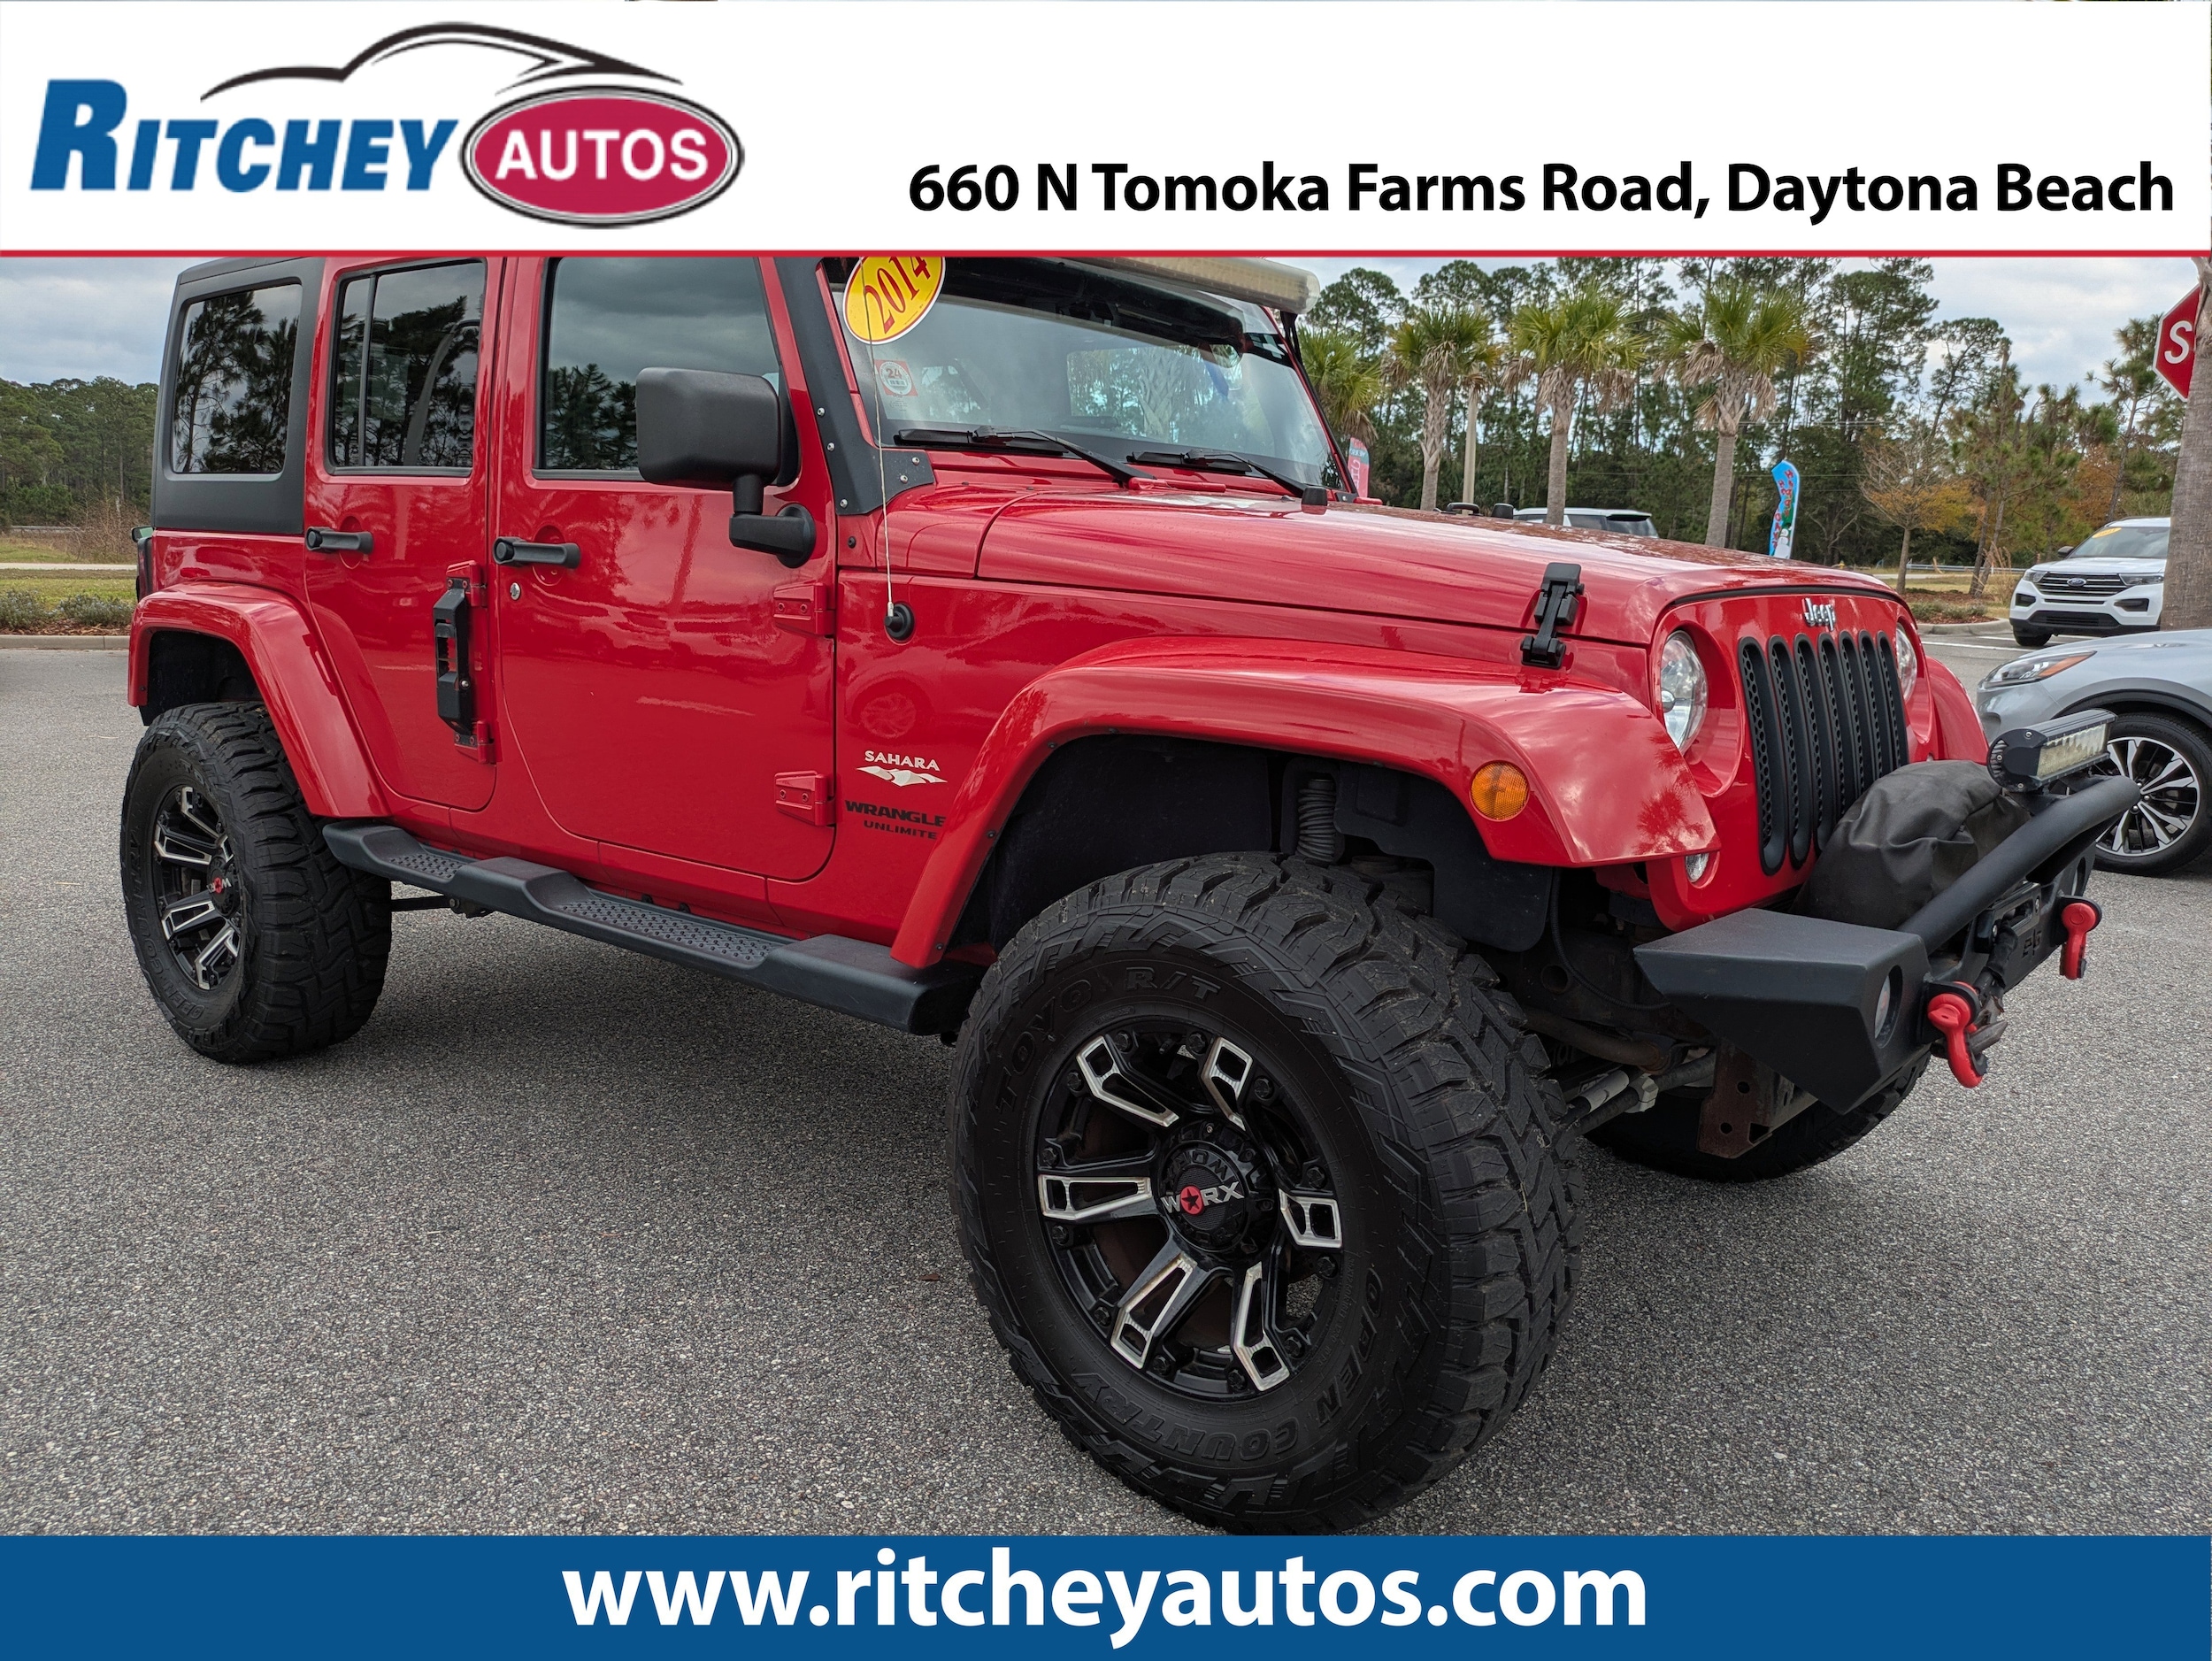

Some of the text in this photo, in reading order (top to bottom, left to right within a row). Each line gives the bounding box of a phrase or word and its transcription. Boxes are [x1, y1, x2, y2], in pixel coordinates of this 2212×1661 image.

[864, 257, 931, 334] 2014
[864, 750, 940, 772] SAHARA
[845, 800, 947, 827] WRANGLE
[864, 820, 937, 840] UNLIMITE
[995, 979, 1094, 1116] TOYO
[1125, 965, 1223, 1001] R/T
[1160, 1180, 1246, 1217] WORX
[1071, 1267, 1384, 1461] OPEN COUNTRY
